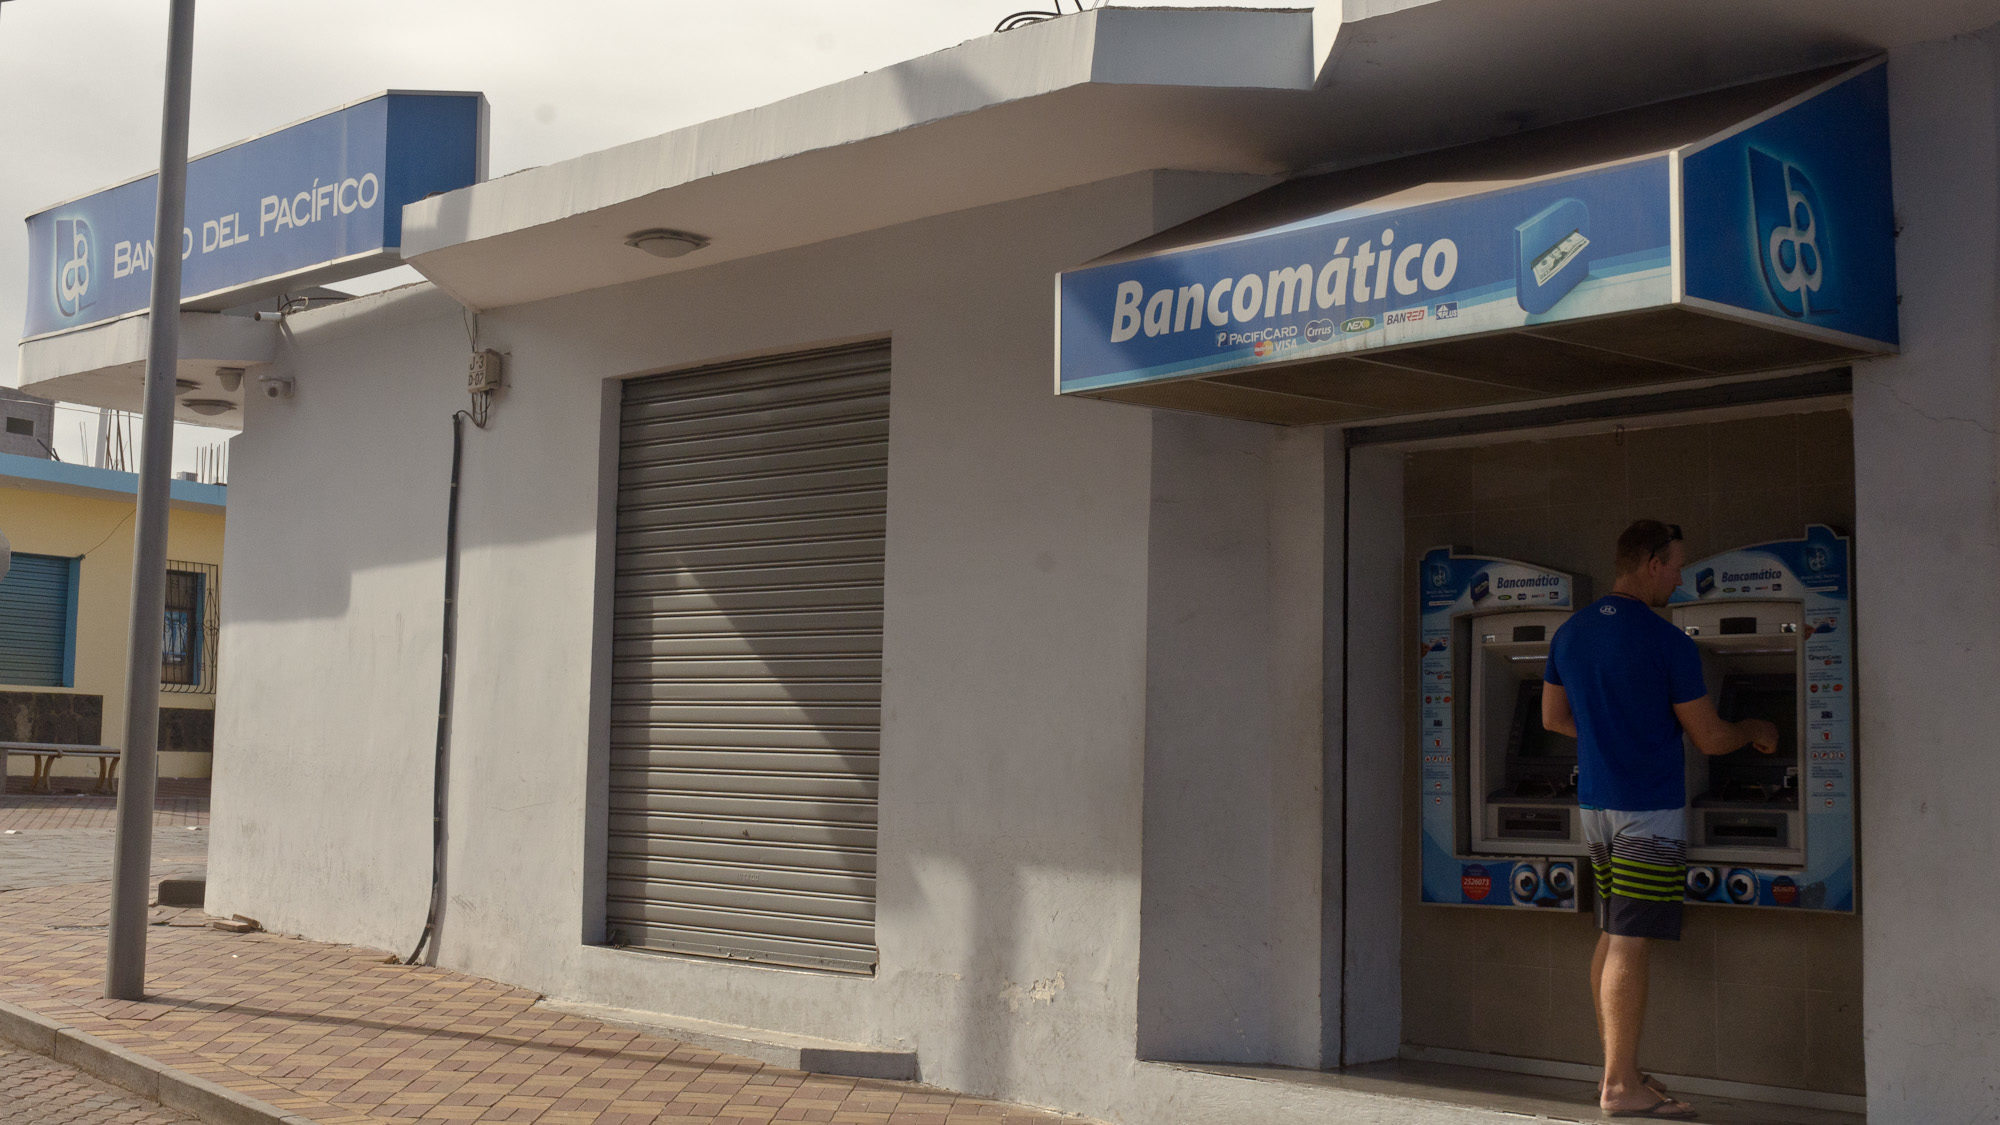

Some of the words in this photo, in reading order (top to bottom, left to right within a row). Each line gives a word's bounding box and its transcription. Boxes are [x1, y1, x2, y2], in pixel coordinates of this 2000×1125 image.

[113, 227, 193, 279] BANO
[202, 212, 249, 255] DEL
[259, 172, 379, 236] PACÍFICO
[1110, 228, 1459, 343] Bancomático
[1386, 309, 1425, 326] BANRED
[1442, 309, 1458, 319] PLUS
[1229, 325, 1298, 346] PACIFICARD
[1306, 326, 1332, 337] Cirrus
[1274, 338, 1298, 353] VISA
[1497, 574, 1560, 589] Bancomático
[1721, 568, 1782, 583] Bancomático
